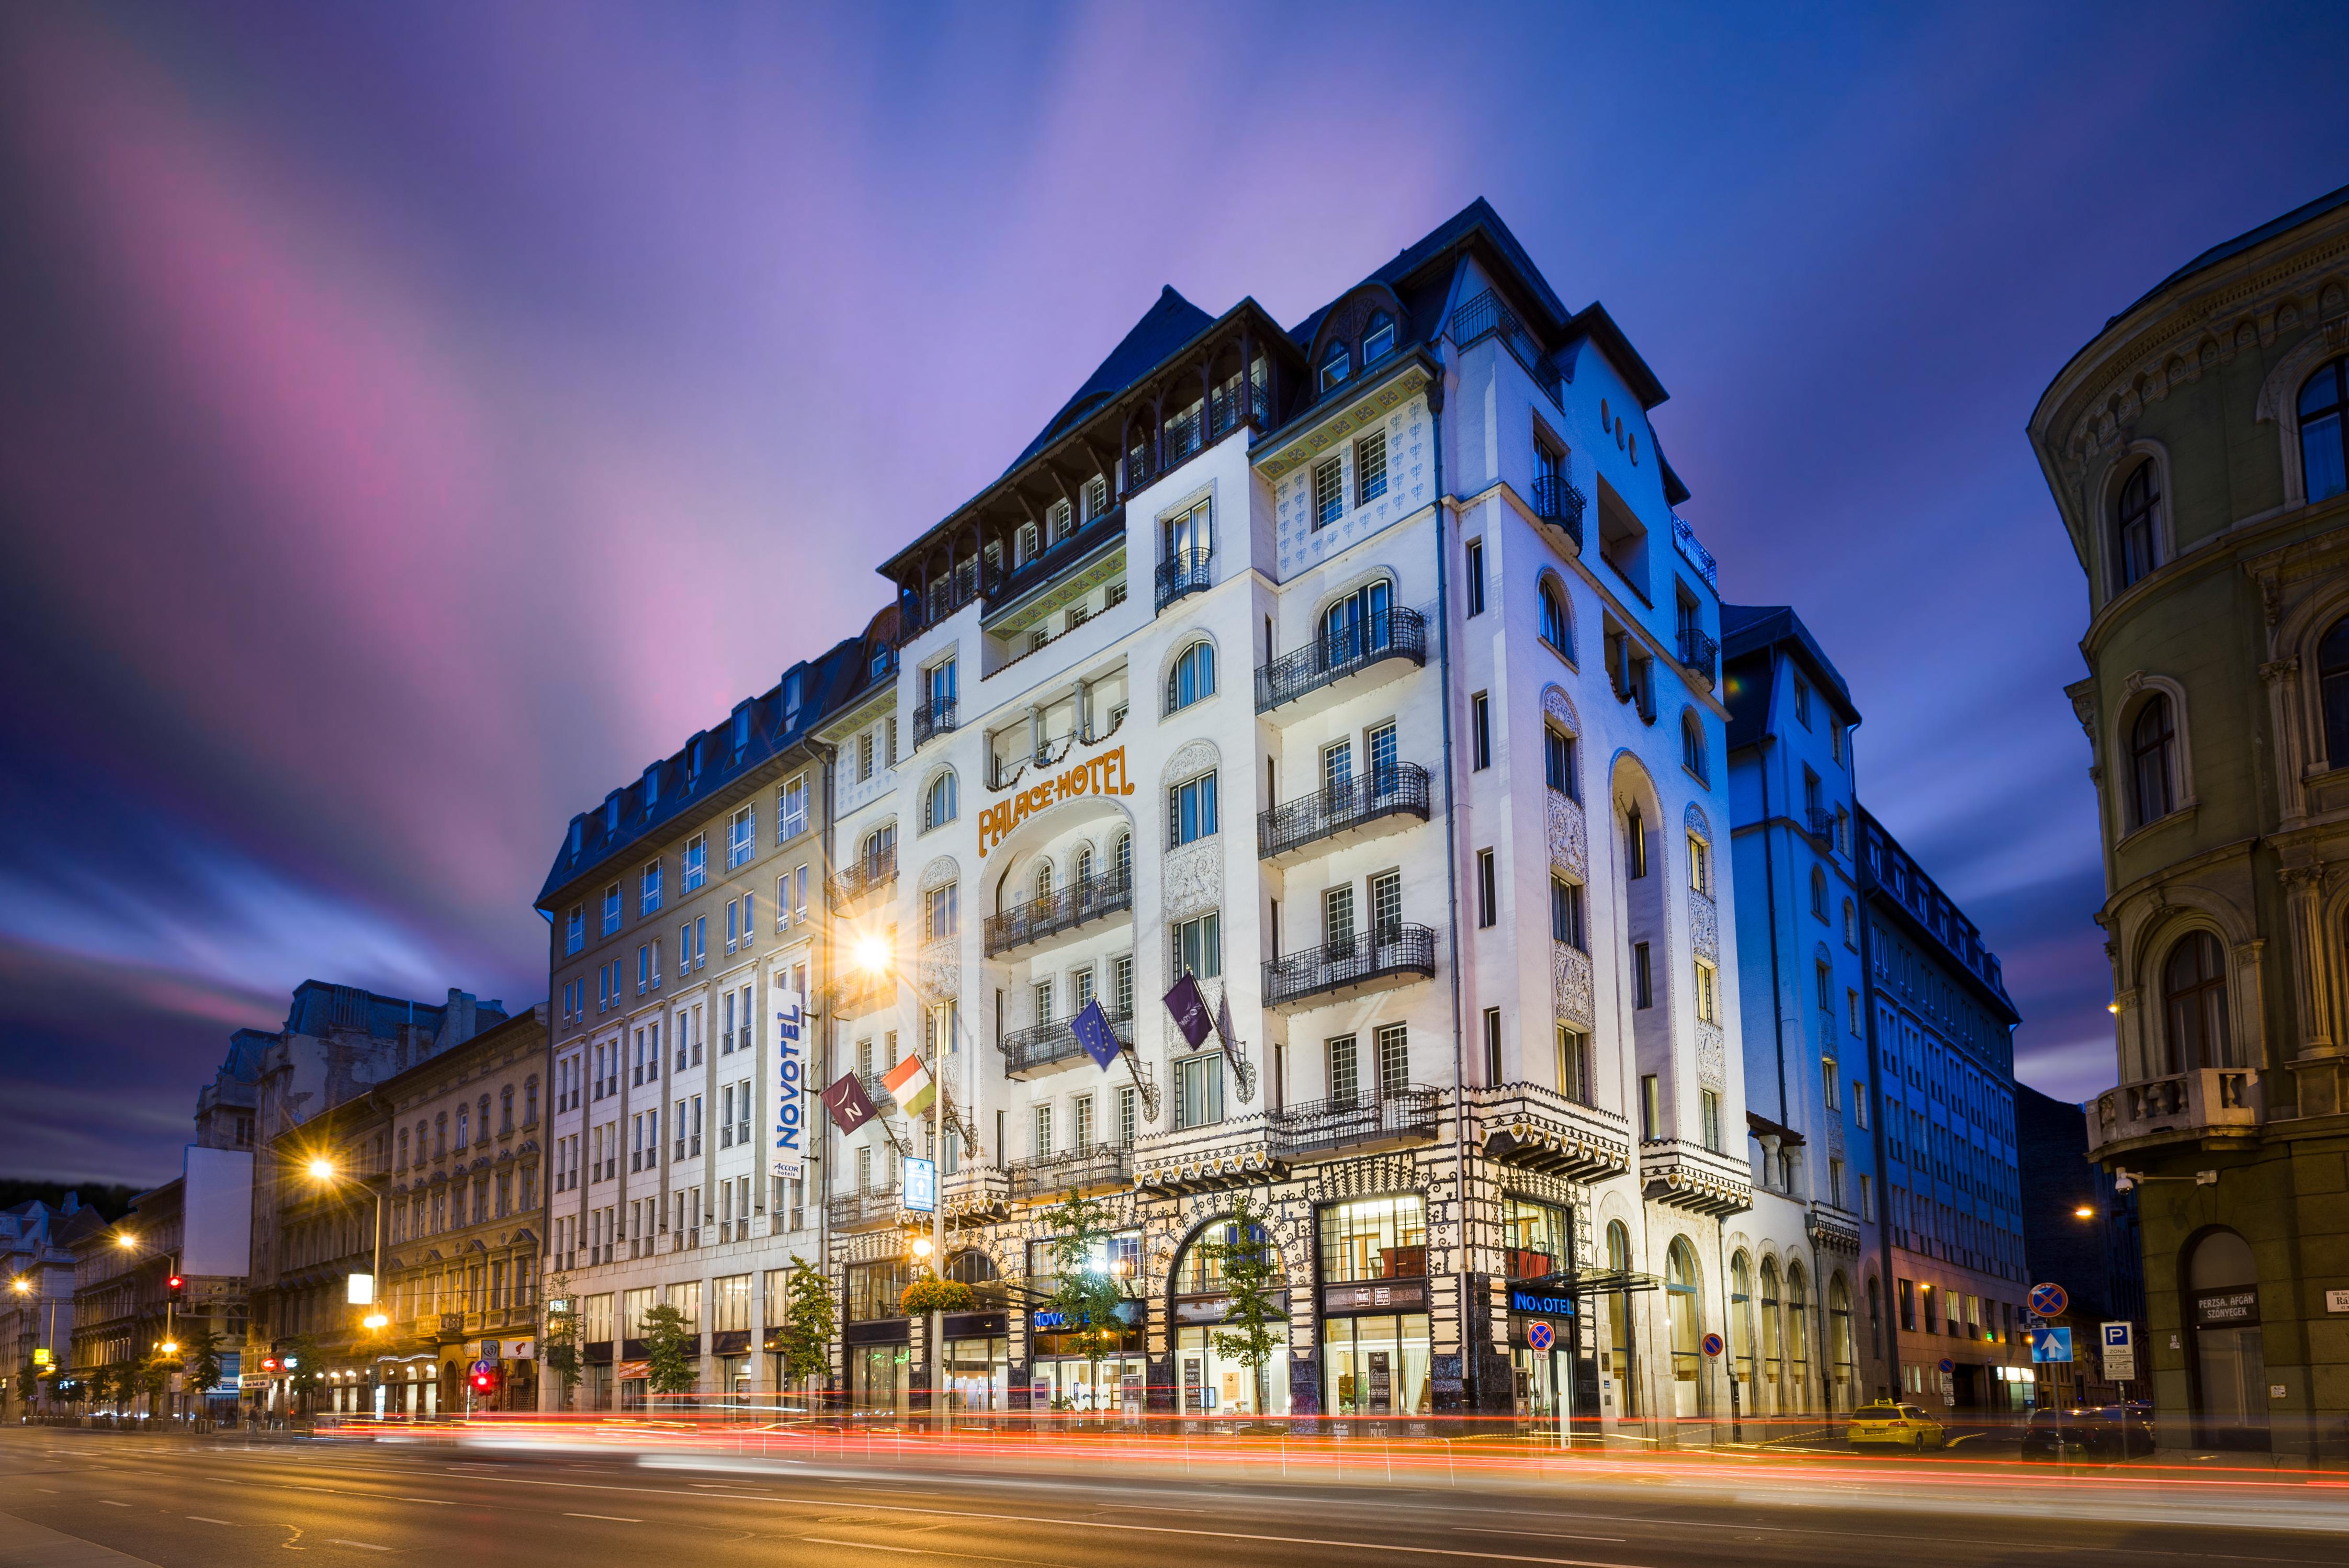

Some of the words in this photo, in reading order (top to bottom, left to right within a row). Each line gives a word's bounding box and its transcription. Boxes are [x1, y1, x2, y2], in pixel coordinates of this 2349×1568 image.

[776, 1004, 801, 1150] NOVOTEL
[773, 1163, 799, 1172] ACCOR
[906, 1160, 932, 1171] SMART
[1514, 1291, 1574, 1315] NOVOTEL
[2230, 1294, 2254, 1306] AFGÁN
[1370, 1428, 1387, 1438] PALACE
